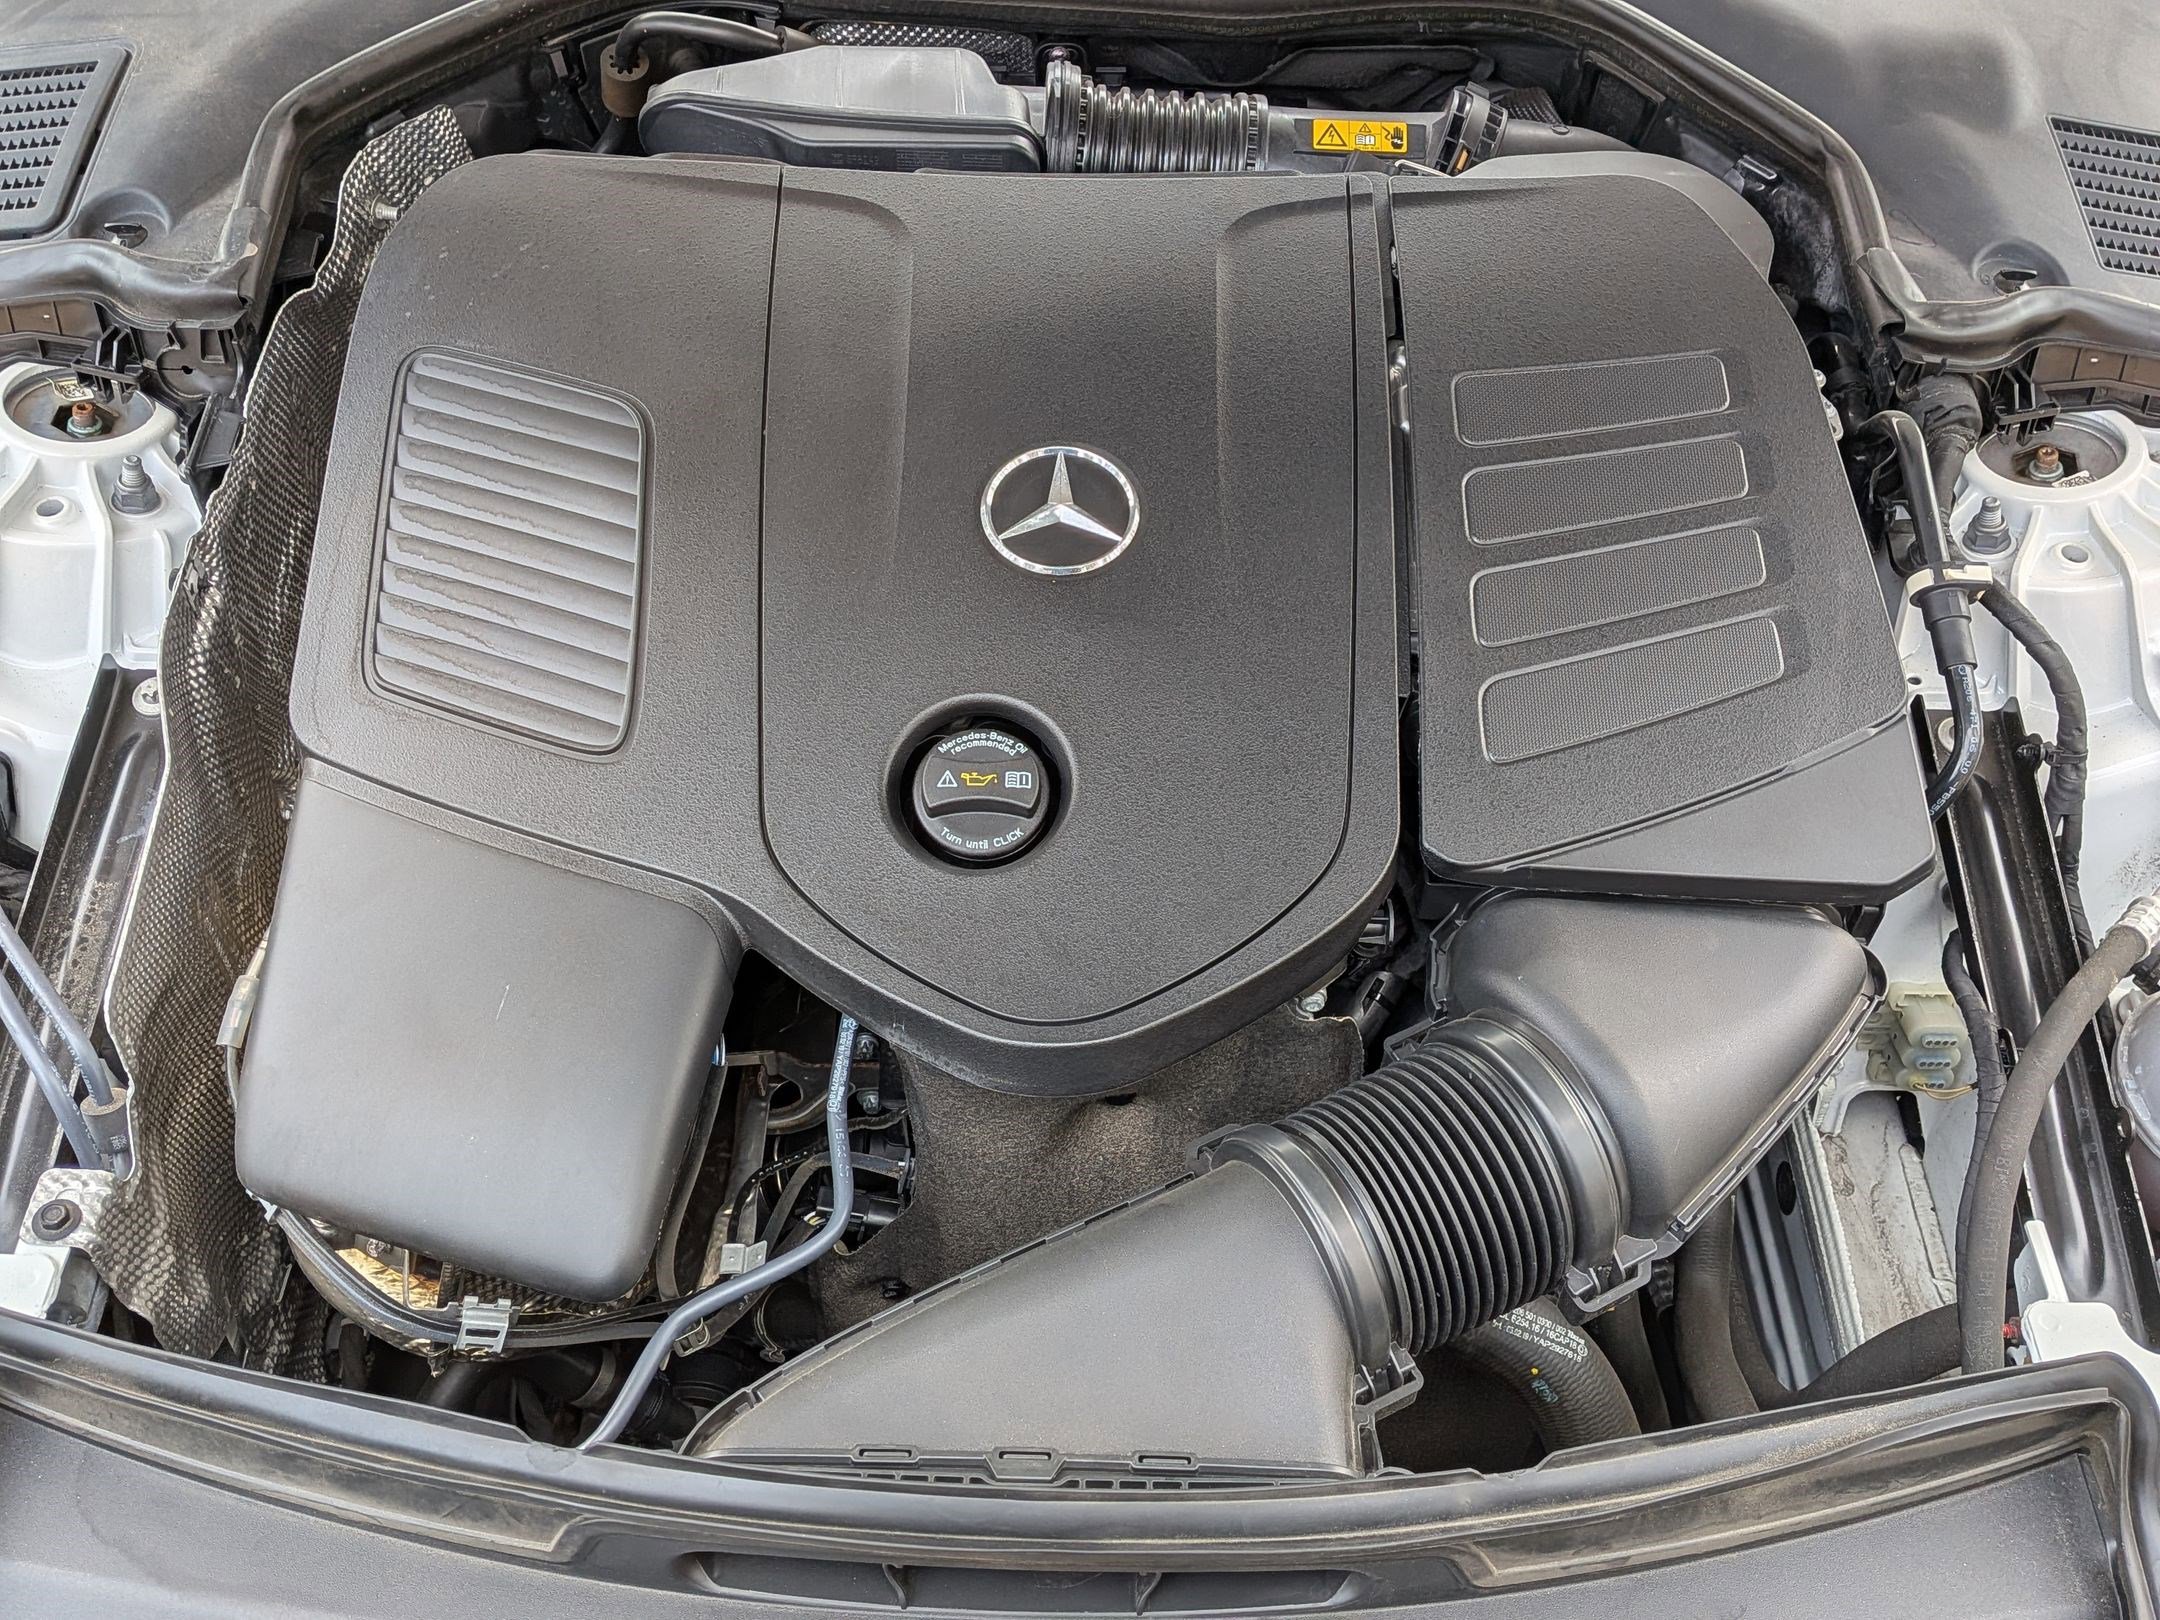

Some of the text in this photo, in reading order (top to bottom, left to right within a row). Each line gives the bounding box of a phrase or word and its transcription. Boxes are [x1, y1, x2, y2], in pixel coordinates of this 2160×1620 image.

[938, 732, 1029, 754] Mercedes-Benz Oil
[950, 739, 1017, 756] recommended
[941, 826, 1024, 849] Turn until CLICK
